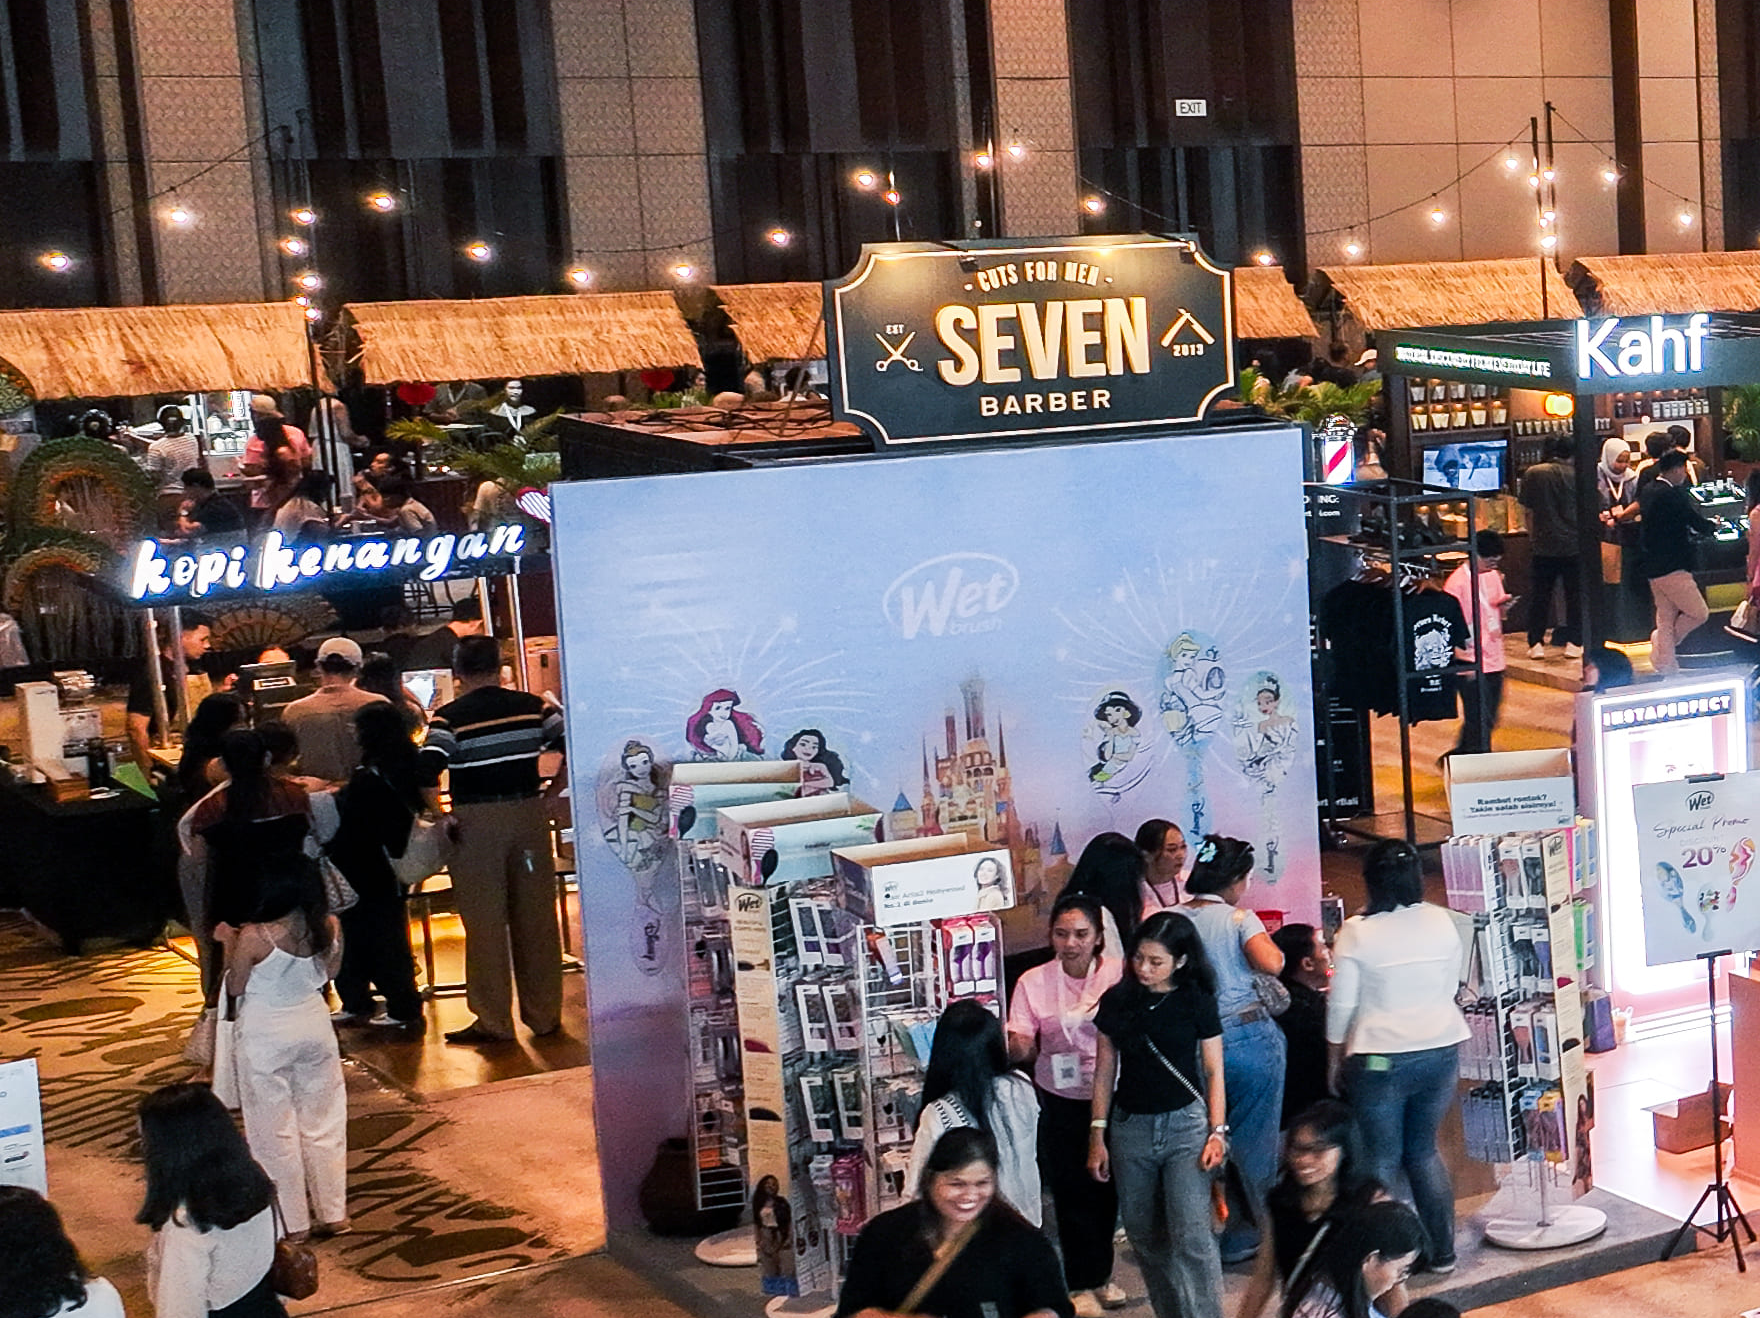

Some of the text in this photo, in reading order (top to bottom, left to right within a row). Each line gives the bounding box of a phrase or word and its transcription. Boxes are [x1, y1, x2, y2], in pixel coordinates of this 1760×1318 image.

[976, 261, 1100, 293] CUTS FOR MEN
[936, 296, 1151, 388] SEVEN
[1172, 342, 1205, 358] 2013
[1576, 312, 1713, 380] Kahf
[979, 389, 1113, 418] BARBER
[132, 521, 526, 601] kopi kenangan
[900, 569, 1008, 641] Wet
[1602, 694, 1732, 728] INSTAPERFECT
[1688, 794, 1712, 812] Wet
[1681, 846, 1727, 869] 20%
